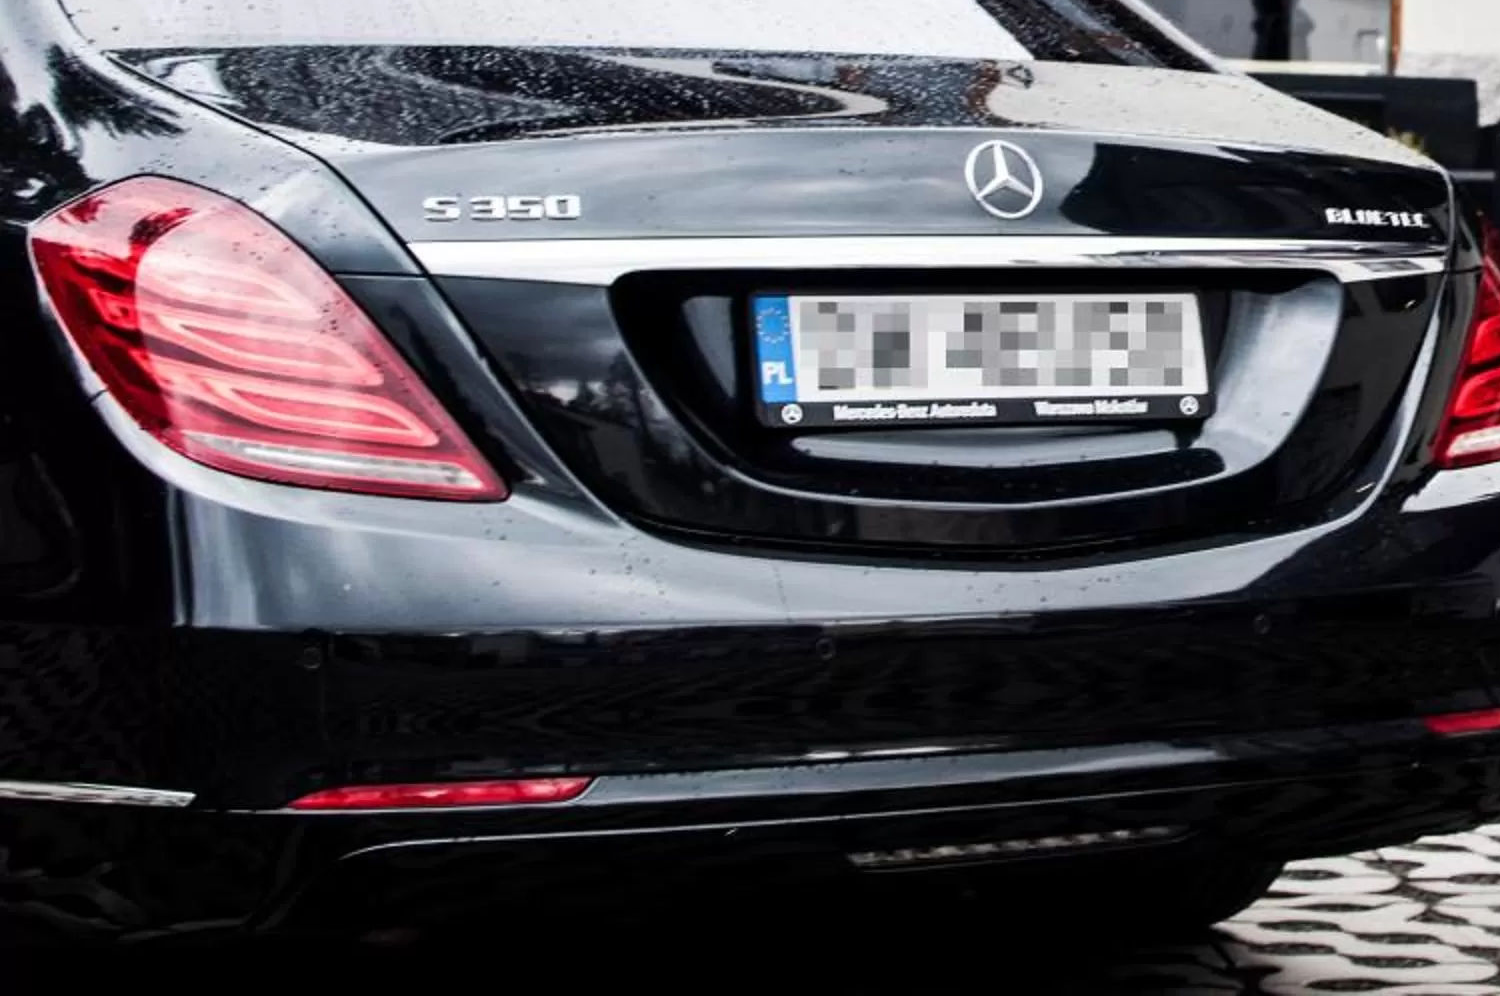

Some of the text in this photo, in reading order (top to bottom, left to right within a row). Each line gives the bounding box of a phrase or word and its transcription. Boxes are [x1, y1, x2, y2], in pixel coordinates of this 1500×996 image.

[422, 194, 582, 222] S 350
[761, 361, 793, 385] PL
